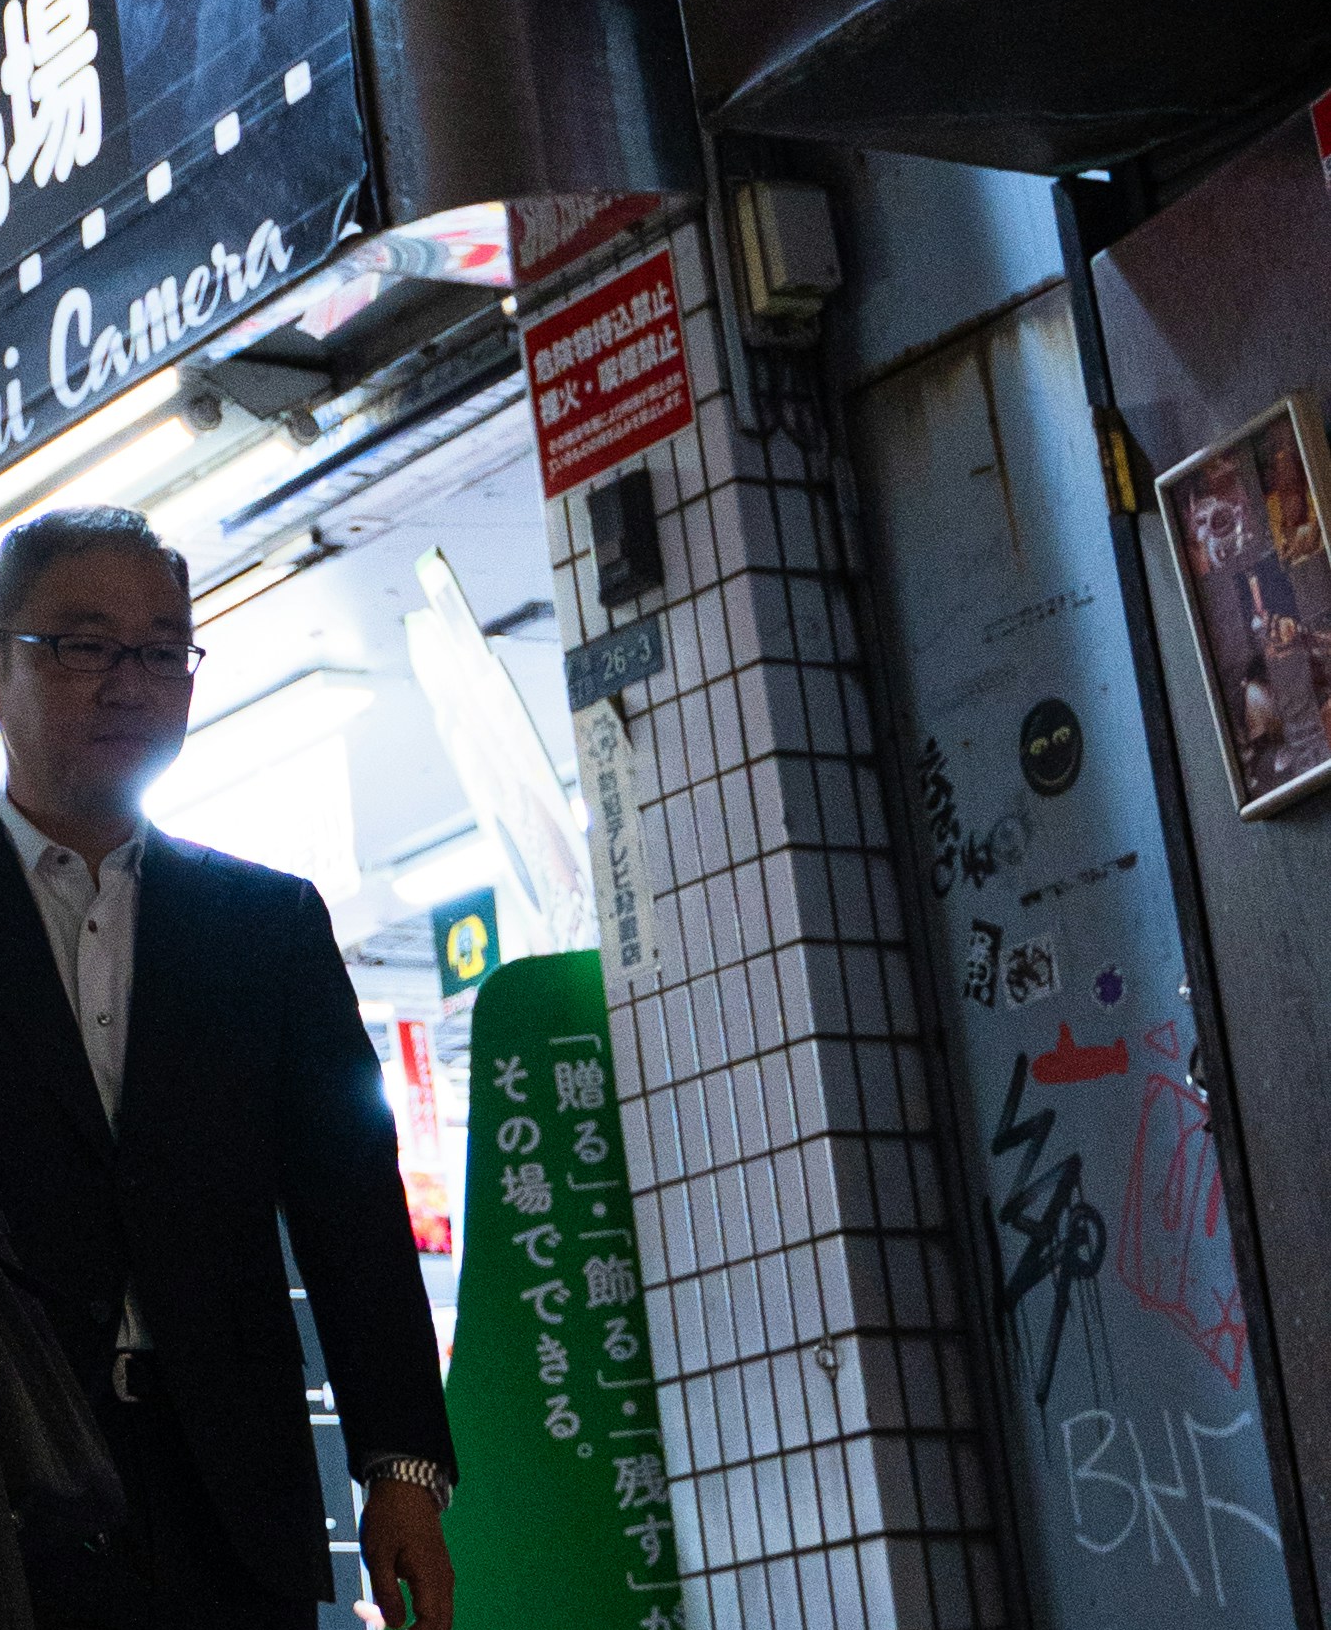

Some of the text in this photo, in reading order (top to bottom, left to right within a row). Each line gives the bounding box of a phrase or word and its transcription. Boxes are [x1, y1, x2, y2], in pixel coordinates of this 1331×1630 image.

[49, 218, 294, 412] Camera
[492, 1055, 594, 1460] その場でできる。
